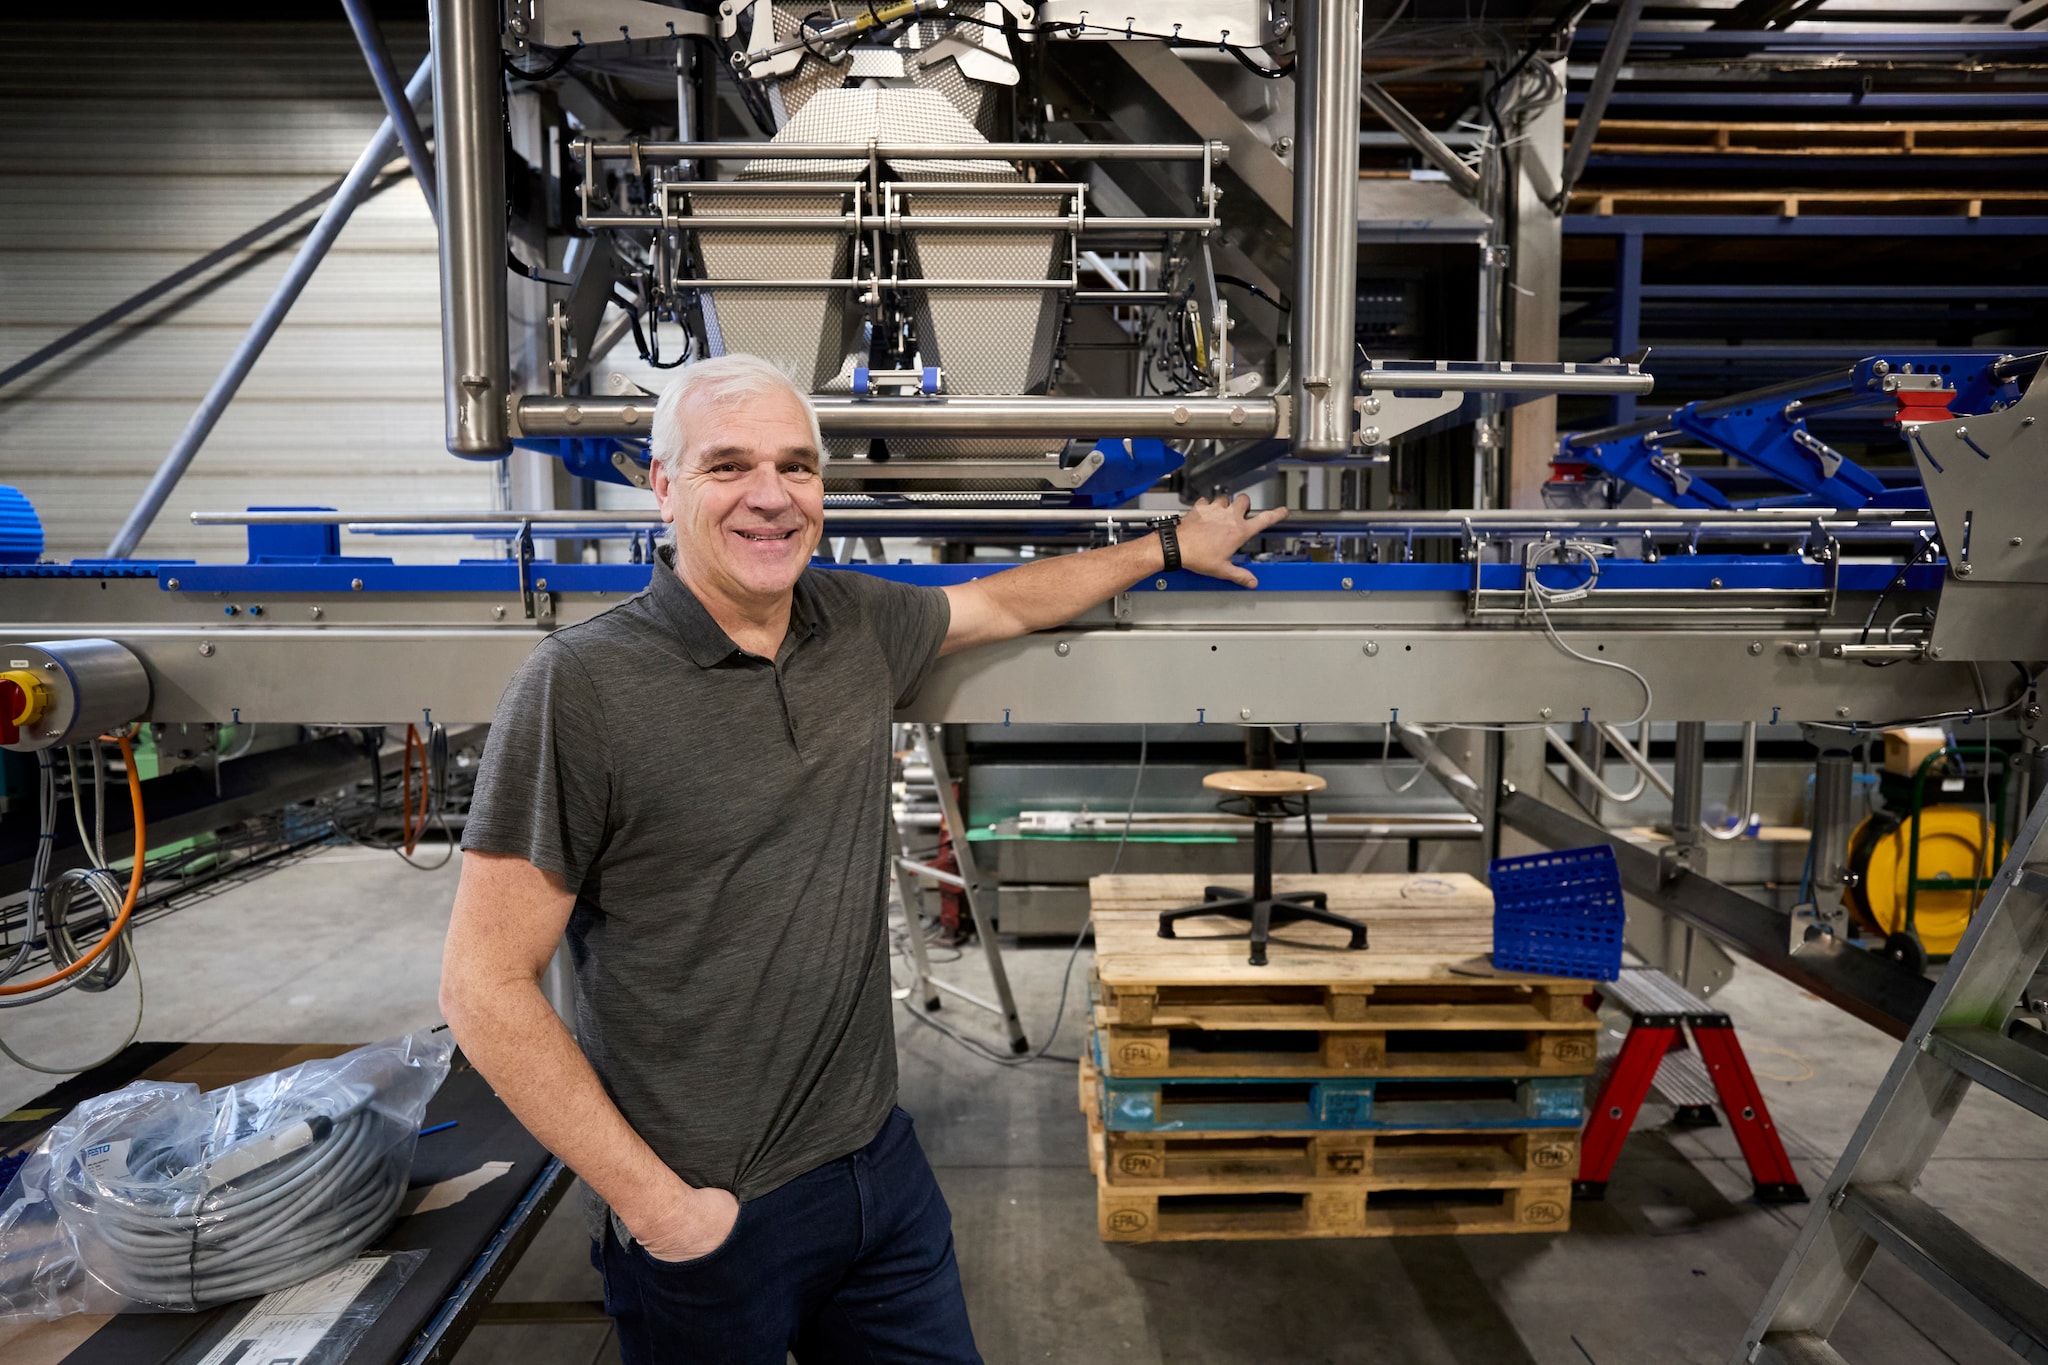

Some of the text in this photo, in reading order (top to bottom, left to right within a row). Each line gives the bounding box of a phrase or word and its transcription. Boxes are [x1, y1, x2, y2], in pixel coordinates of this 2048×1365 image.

[1124, 1047, 1153, 1061] EPAL
[1559, 1044, 1588, 1059] EPAL
[87, 1144, 111, 1157] FESTO
[1540, 1150, 1565, 1165] EPAL
[1529, 1204, 1557, 1219] EPAL
[1112, 1214, 1140, 1229] EPAL
